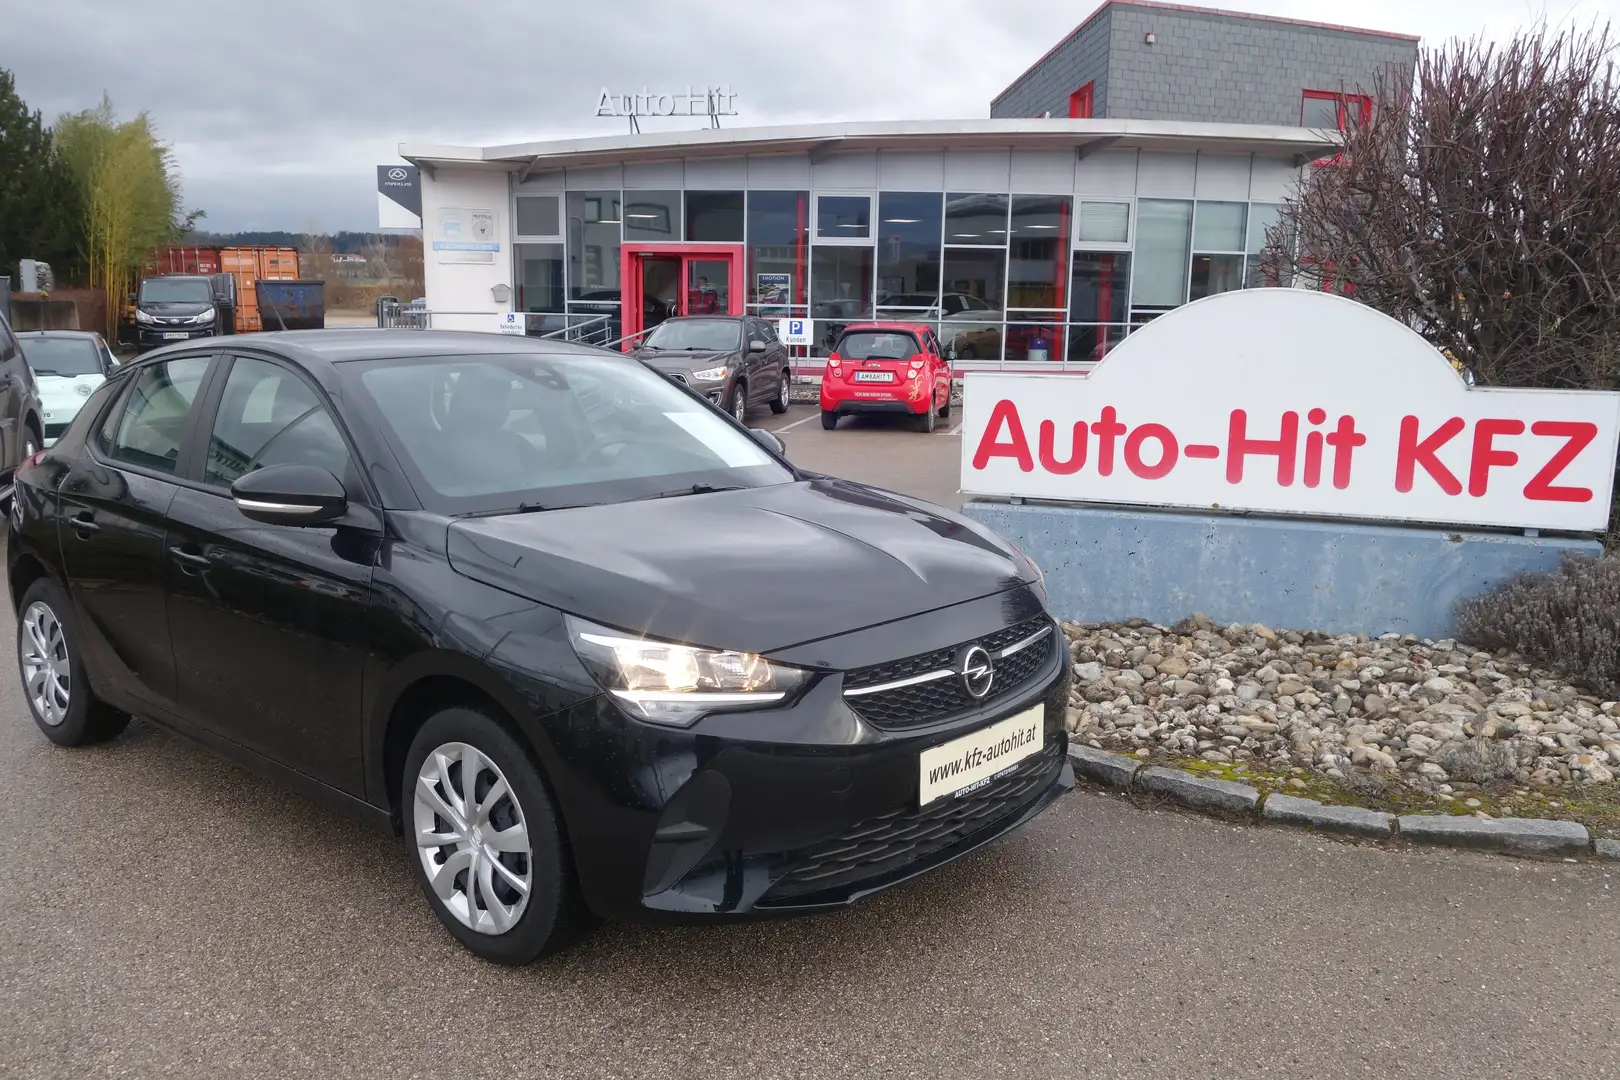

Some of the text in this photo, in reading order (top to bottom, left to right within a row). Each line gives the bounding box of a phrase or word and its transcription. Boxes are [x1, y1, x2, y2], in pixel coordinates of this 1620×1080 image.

[596, 83, 738, 116] Auto Hit
[972, 399, 1598, 502] Auto-Hit KFZ
[929, 724, 1036, 784] www.kfz-autohit.at
[954, 776, 990, 798] AUTO-HIT-KFZ
